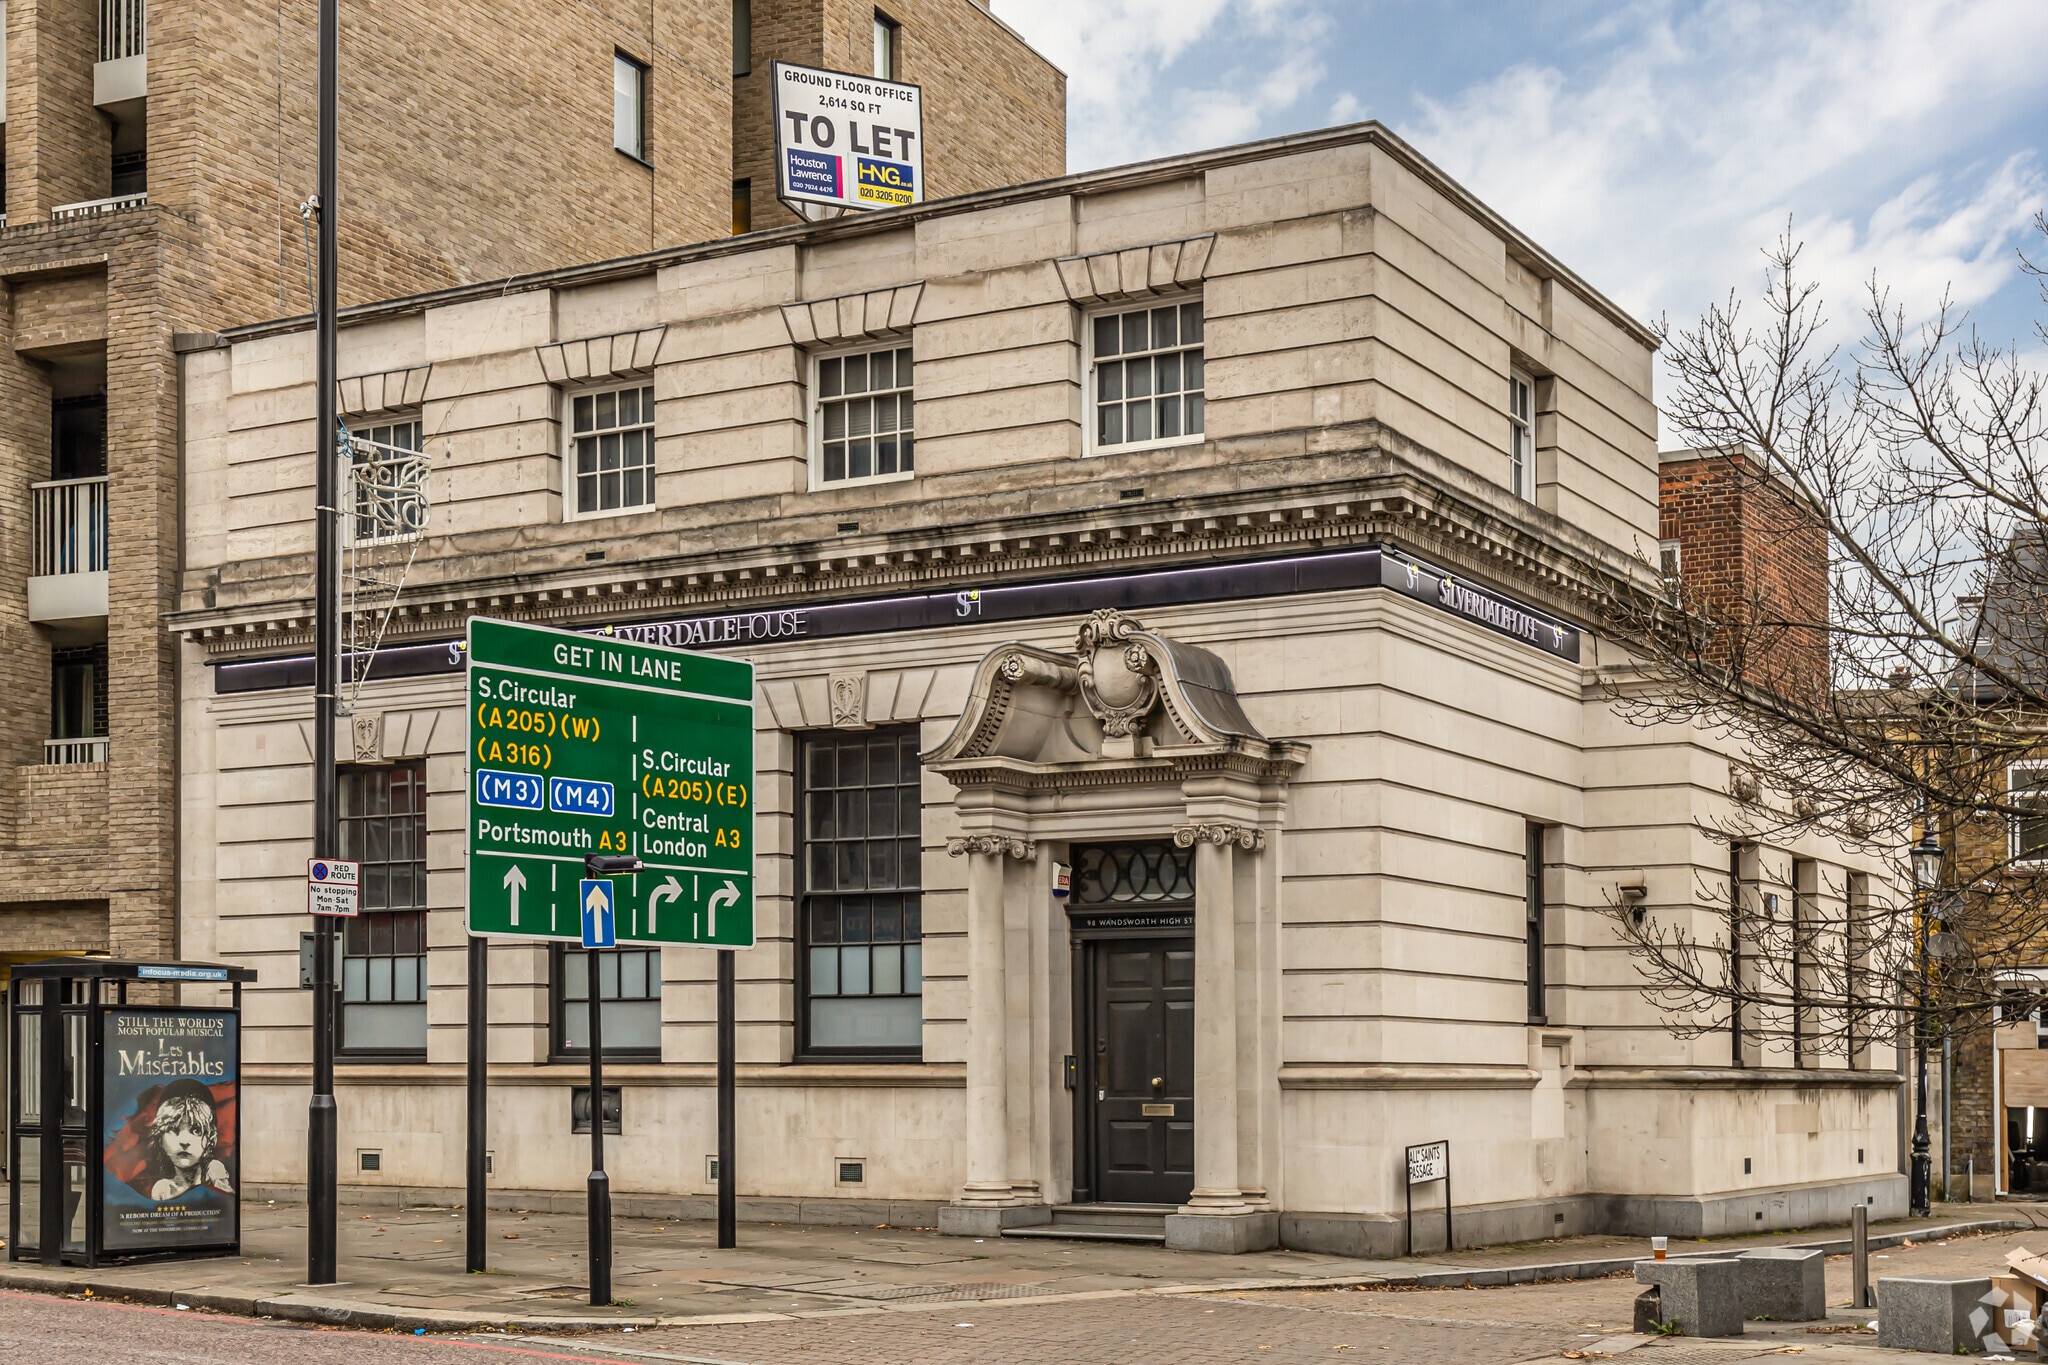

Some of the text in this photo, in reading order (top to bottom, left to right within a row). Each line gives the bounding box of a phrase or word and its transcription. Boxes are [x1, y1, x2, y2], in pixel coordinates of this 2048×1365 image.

[784, 70, 914, 102] GROUND FLOOR OFFICE
[819, 95, 882, 115] 2,614 SQ FT
[785, 110, 915, 161] TO LET
[790, 154, 828, 170] Houston
[791, 166, 833, 183] Lawrence
[792, 181, 803, 189] 020
[860, 187, 912, 204] 020 3205 0200
[553, 643, 682, 682] GET IN LANE
[478, 677, 576, 709] S.Circular
[477, 737, 552, 770] (A316)
[642, 749, 730, 777] S.Circular
[481, 777, 610, 812] (M3) (M4)
[642, 808, 709, 833] Central
[478, 819, 627, 851] Portsmouth A3
[715, 828, 740, 848] A3
[643, 834, 707, 858] London
[331, 872, 356, 880] ROUTE
[334, 864, 350, 872] RED
[310, 885, 357, 896] No stopping
[1098, 918, 1157, 926] WANDSWORTH
[1160, 917, 1181, 925] HIGH
[142, 968, 223, 979] infocus-media.org.uk
[117, 1016, 224, 1029] STILL THE WORLD'S
[117, 1027, 223, 1037] MOST POPULAR MUSICAL
[158, 1038, 183, 1057] Les
[118, 1050, 224, 1076] Misérables
